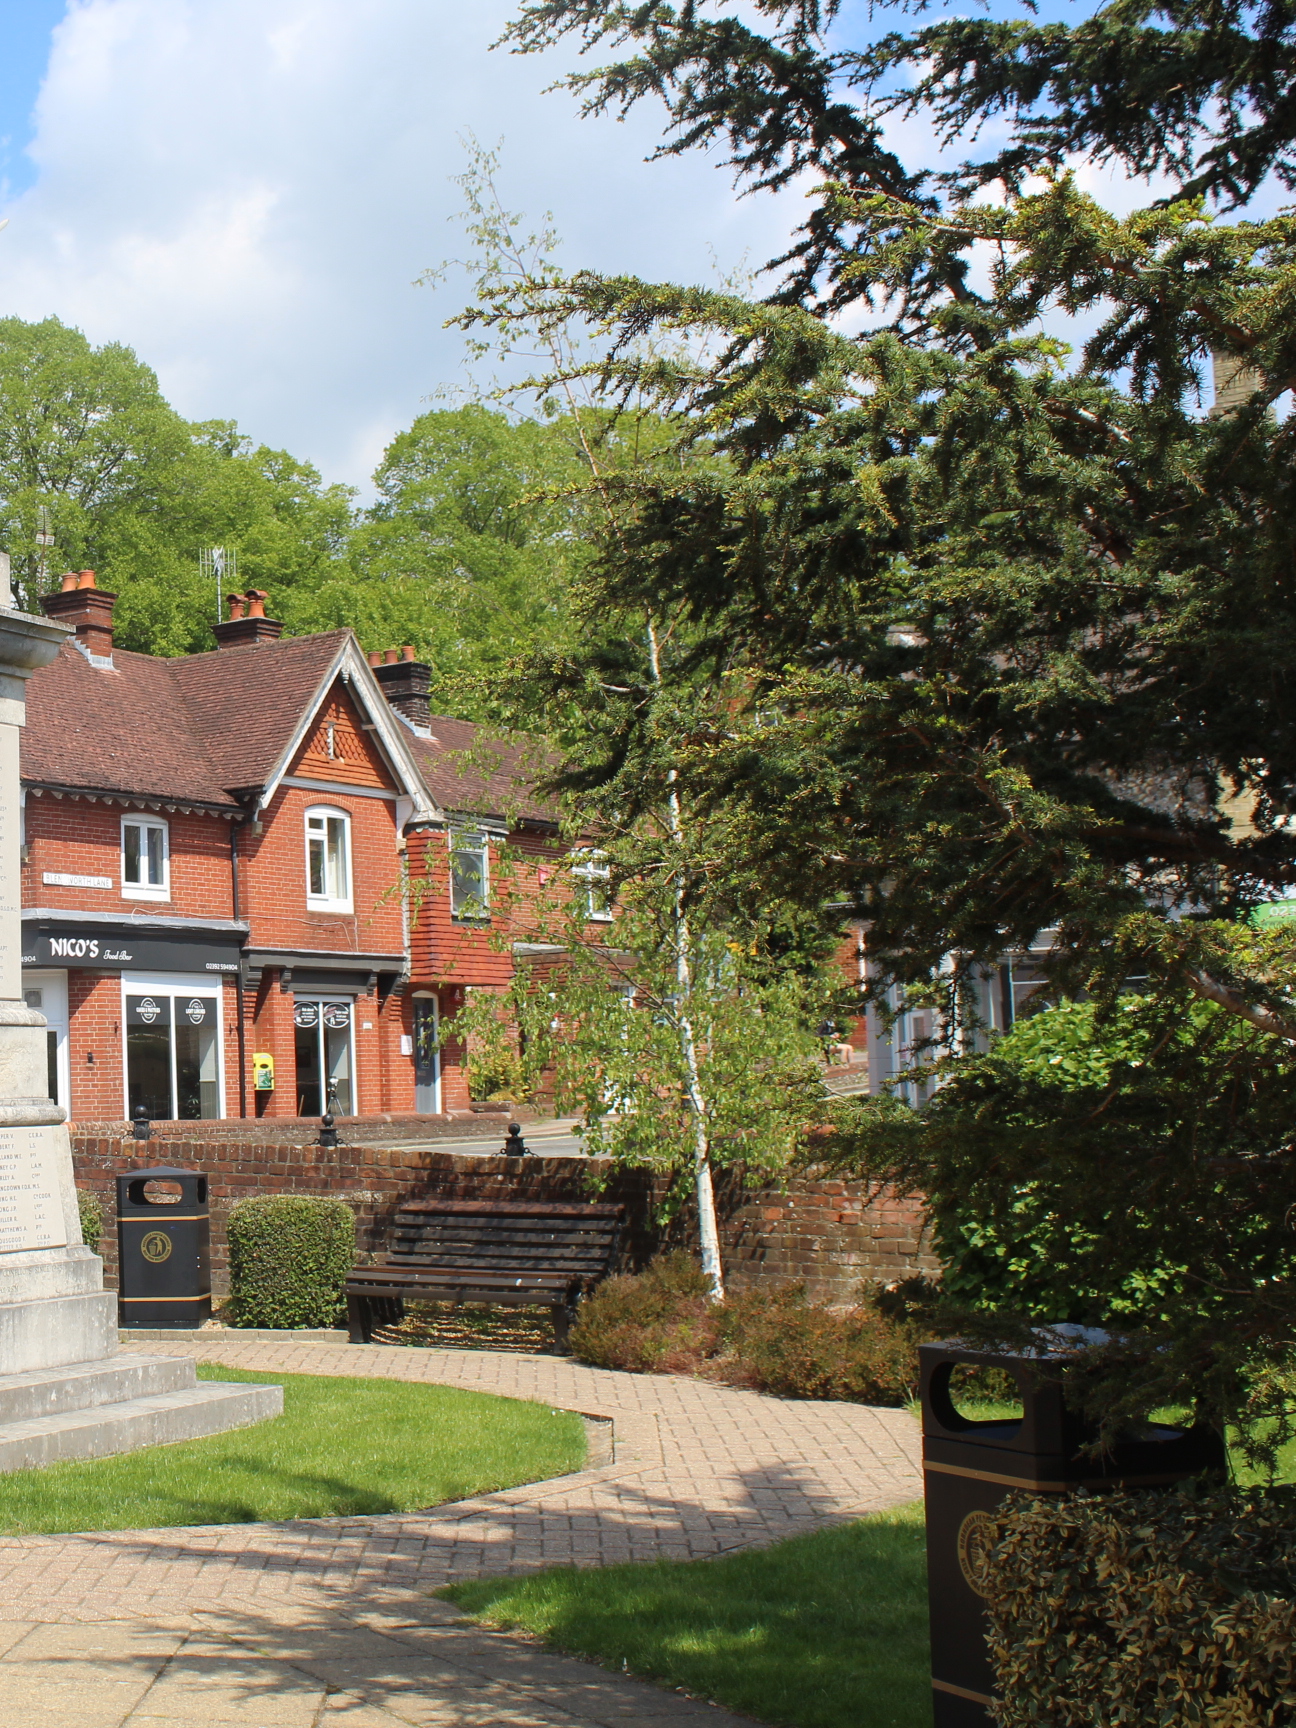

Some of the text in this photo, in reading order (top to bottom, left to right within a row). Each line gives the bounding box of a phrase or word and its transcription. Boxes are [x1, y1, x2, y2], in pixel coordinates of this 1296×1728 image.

[45, 873, 110, 887] BLENWORTH LANE
[49, 938, 133, 961] NICO'S Food Bar
